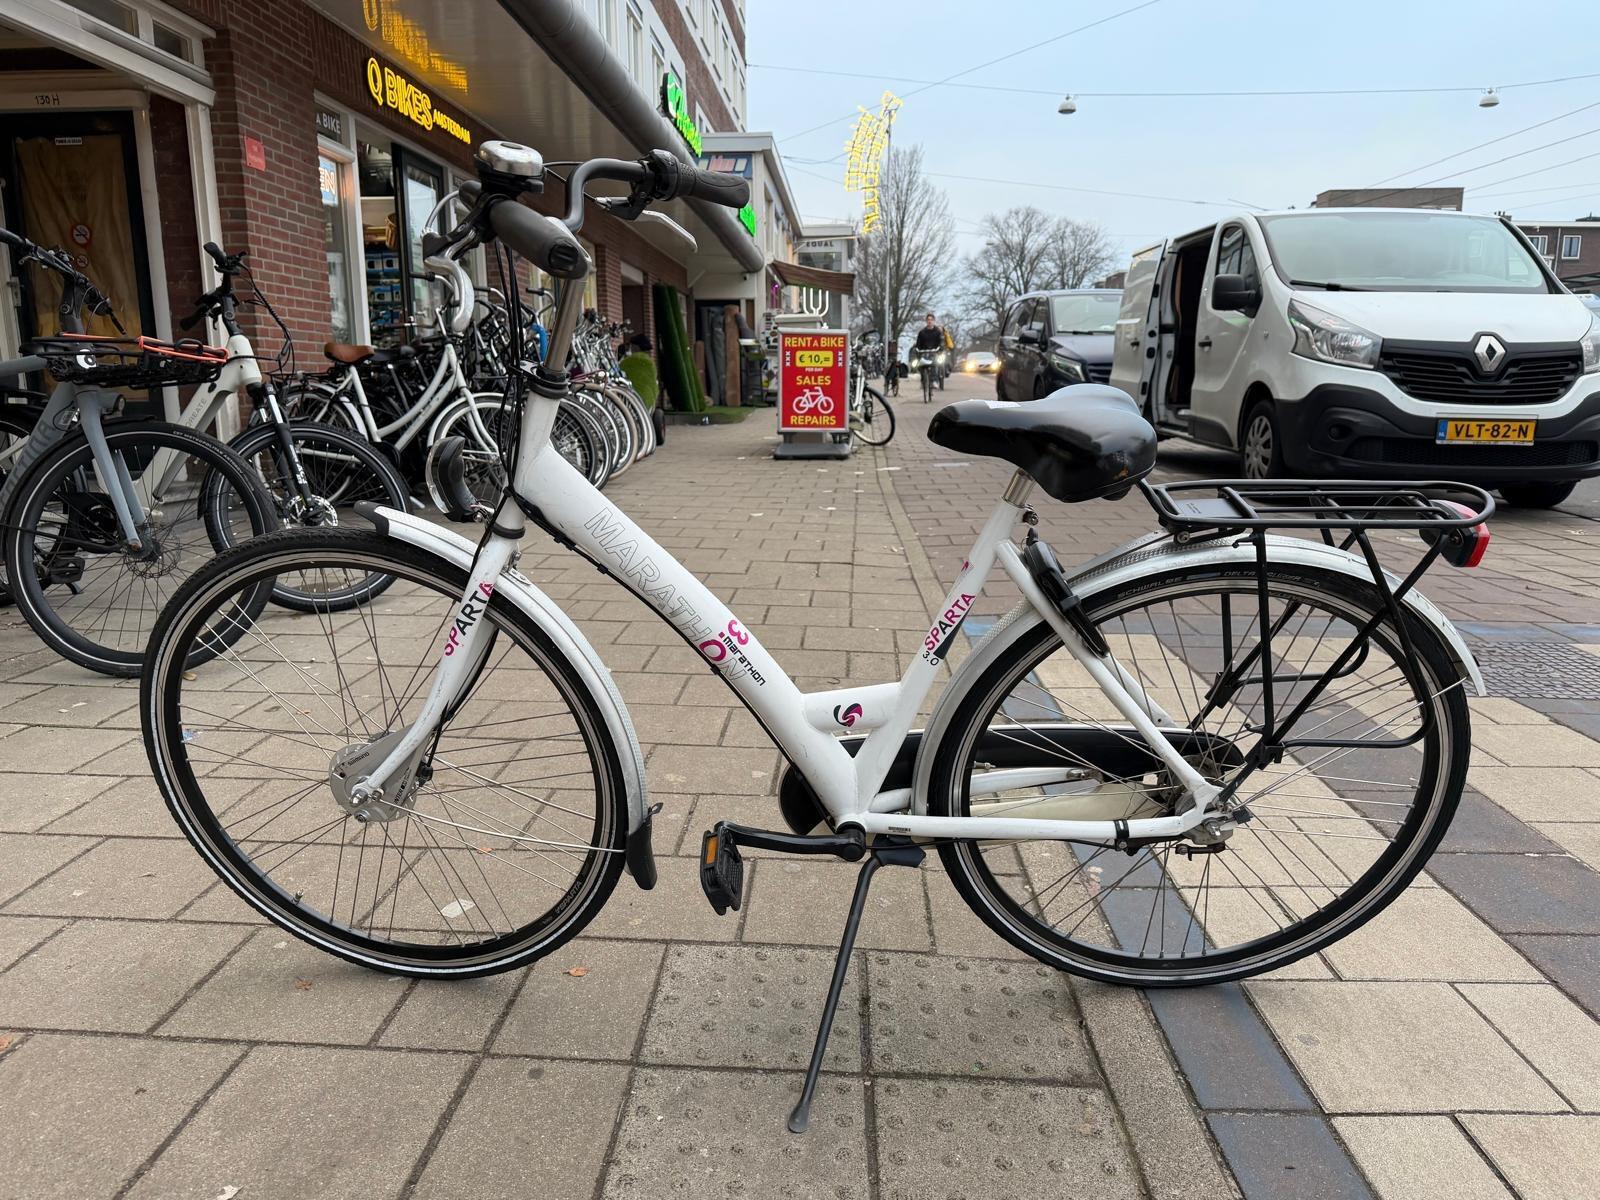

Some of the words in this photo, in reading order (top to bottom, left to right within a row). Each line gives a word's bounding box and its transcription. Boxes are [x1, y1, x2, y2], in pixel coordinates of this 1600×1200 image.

[35, 95, 50, 105] 130
[52, 93, 60, 106] H
[367, 57, 383, 106] Q
[384, 66, 433, 130] BIKES
[433, 109, 471, 145] AMSTERDAM
[322, 113, 341, 134] BIKE
[806, 240, 834, 248] EQUAL
[784, 337, 812, 347] RENT
[820, 337, 844, 347] BIKE
[796, 375, 831, 385] SALES
[790, 415, 836, 425] REPAIRS
[1454, 423, 1529, 438] VLT-82-N
[584, 507, 748, 682] MARATHON
[1117, 576, 1183, 599] SCHWALBE
[444, 582, 493, 656] SPARTA
[925, 593, 976, 651] SPARTA
[922, 650, 939, 666] 3.0
